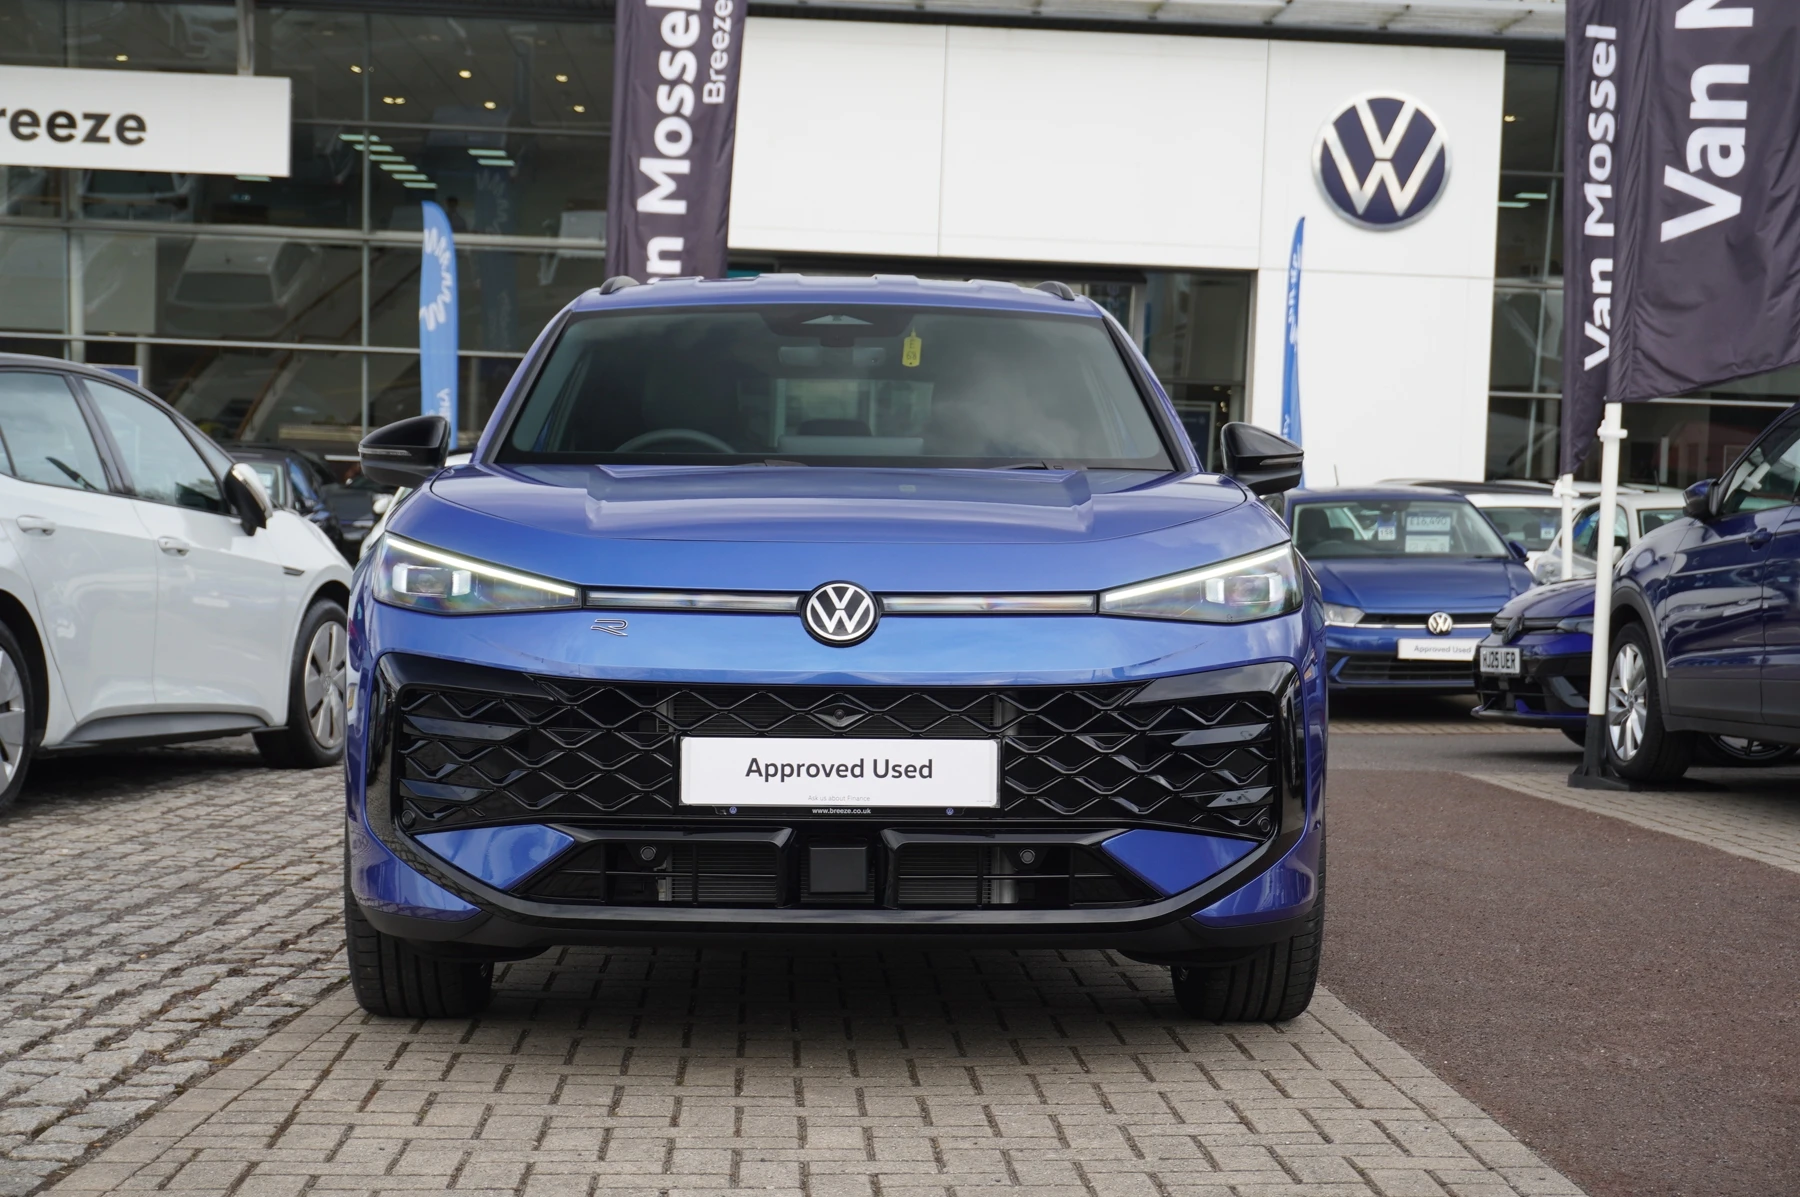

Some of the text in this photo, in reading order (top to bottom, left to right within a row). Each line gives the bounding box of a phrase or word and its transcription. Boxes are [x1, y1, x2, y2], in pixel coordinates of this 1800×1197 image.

[702, 0, 734, 104] Breeze
[0, 108, 147, 146] eeze
[1660, 64, 1750, 243] Van
[1584, 24, 1617, 371] Van Mossel
[1413, 645, 1472, 654] Approved Used
[745, 757, 934, 783] Approved Used
[811, 807, 872, 815] www.breeze.co.uk
